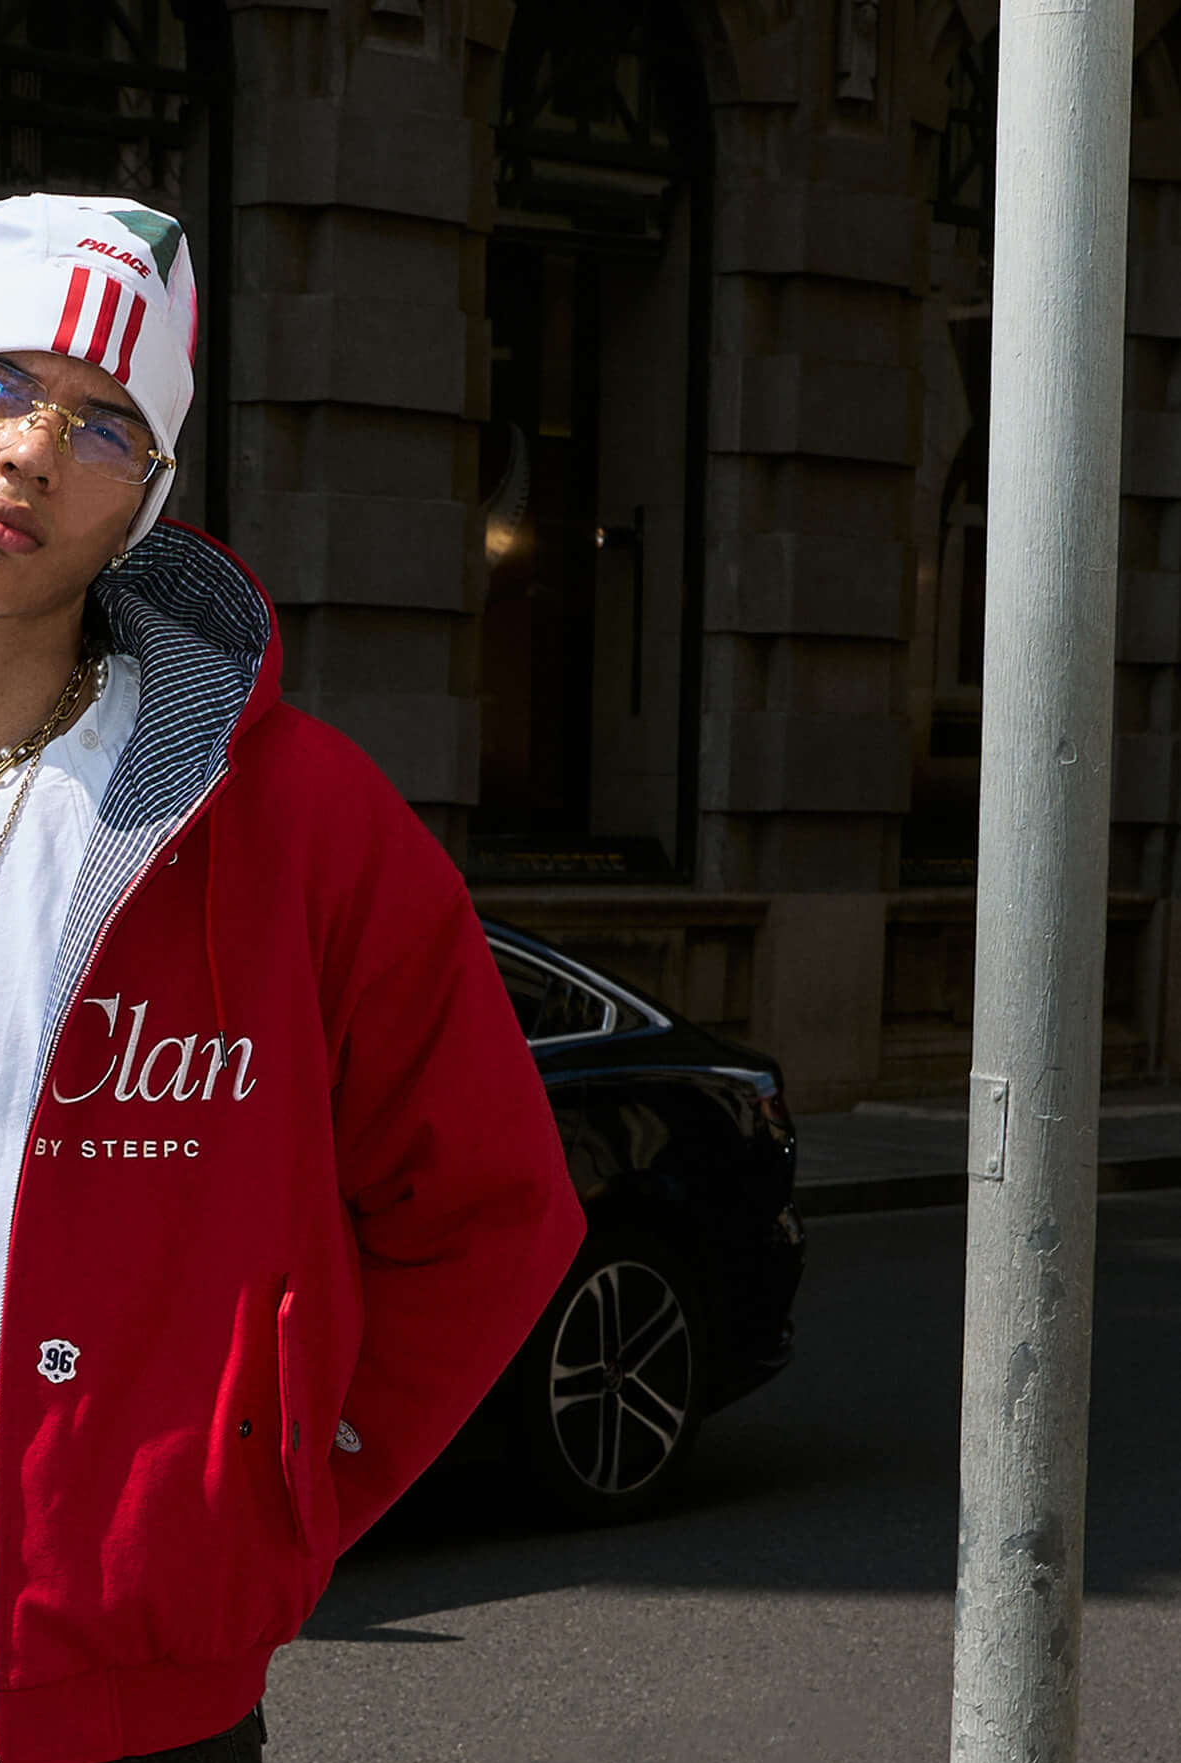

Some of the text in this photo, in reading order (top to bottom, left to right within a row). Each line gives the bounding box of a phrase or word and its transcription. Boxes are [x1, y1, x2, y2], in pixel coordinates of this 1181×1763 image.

[76, 238, 152, 279] PALACE
[52, 992, 257, 1104] Clan
[35, 1138, 62, 1157] BY
[81, 1139, 200, 1158] STEEPC
[44, 1348, 74, 1373] 96
